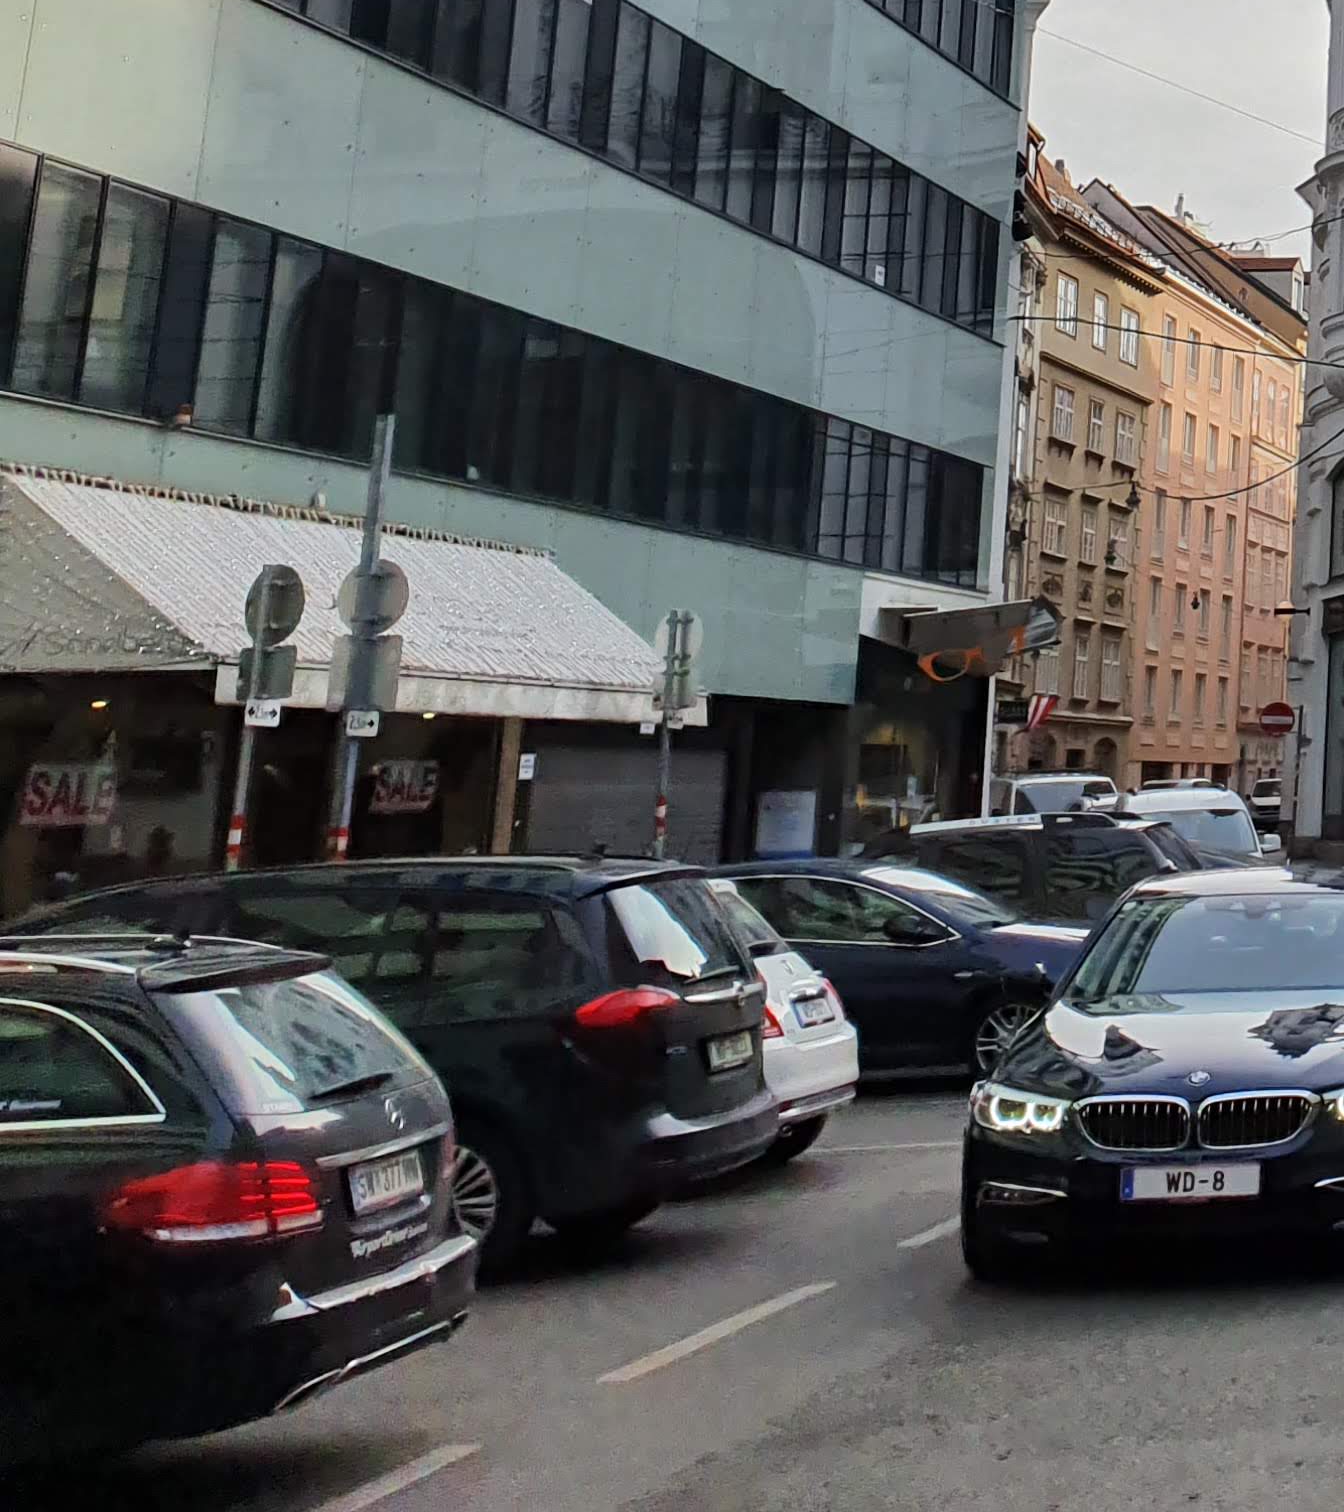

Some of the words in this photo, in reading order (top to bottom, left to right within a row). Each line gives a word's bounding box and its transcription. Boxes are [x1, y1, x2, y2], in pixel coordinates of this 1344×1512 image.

[26, 769, 114, 816] SALE
[375, 764, 437, 804] SALE
[1166, 1170, 1225, 1193] WD-8
